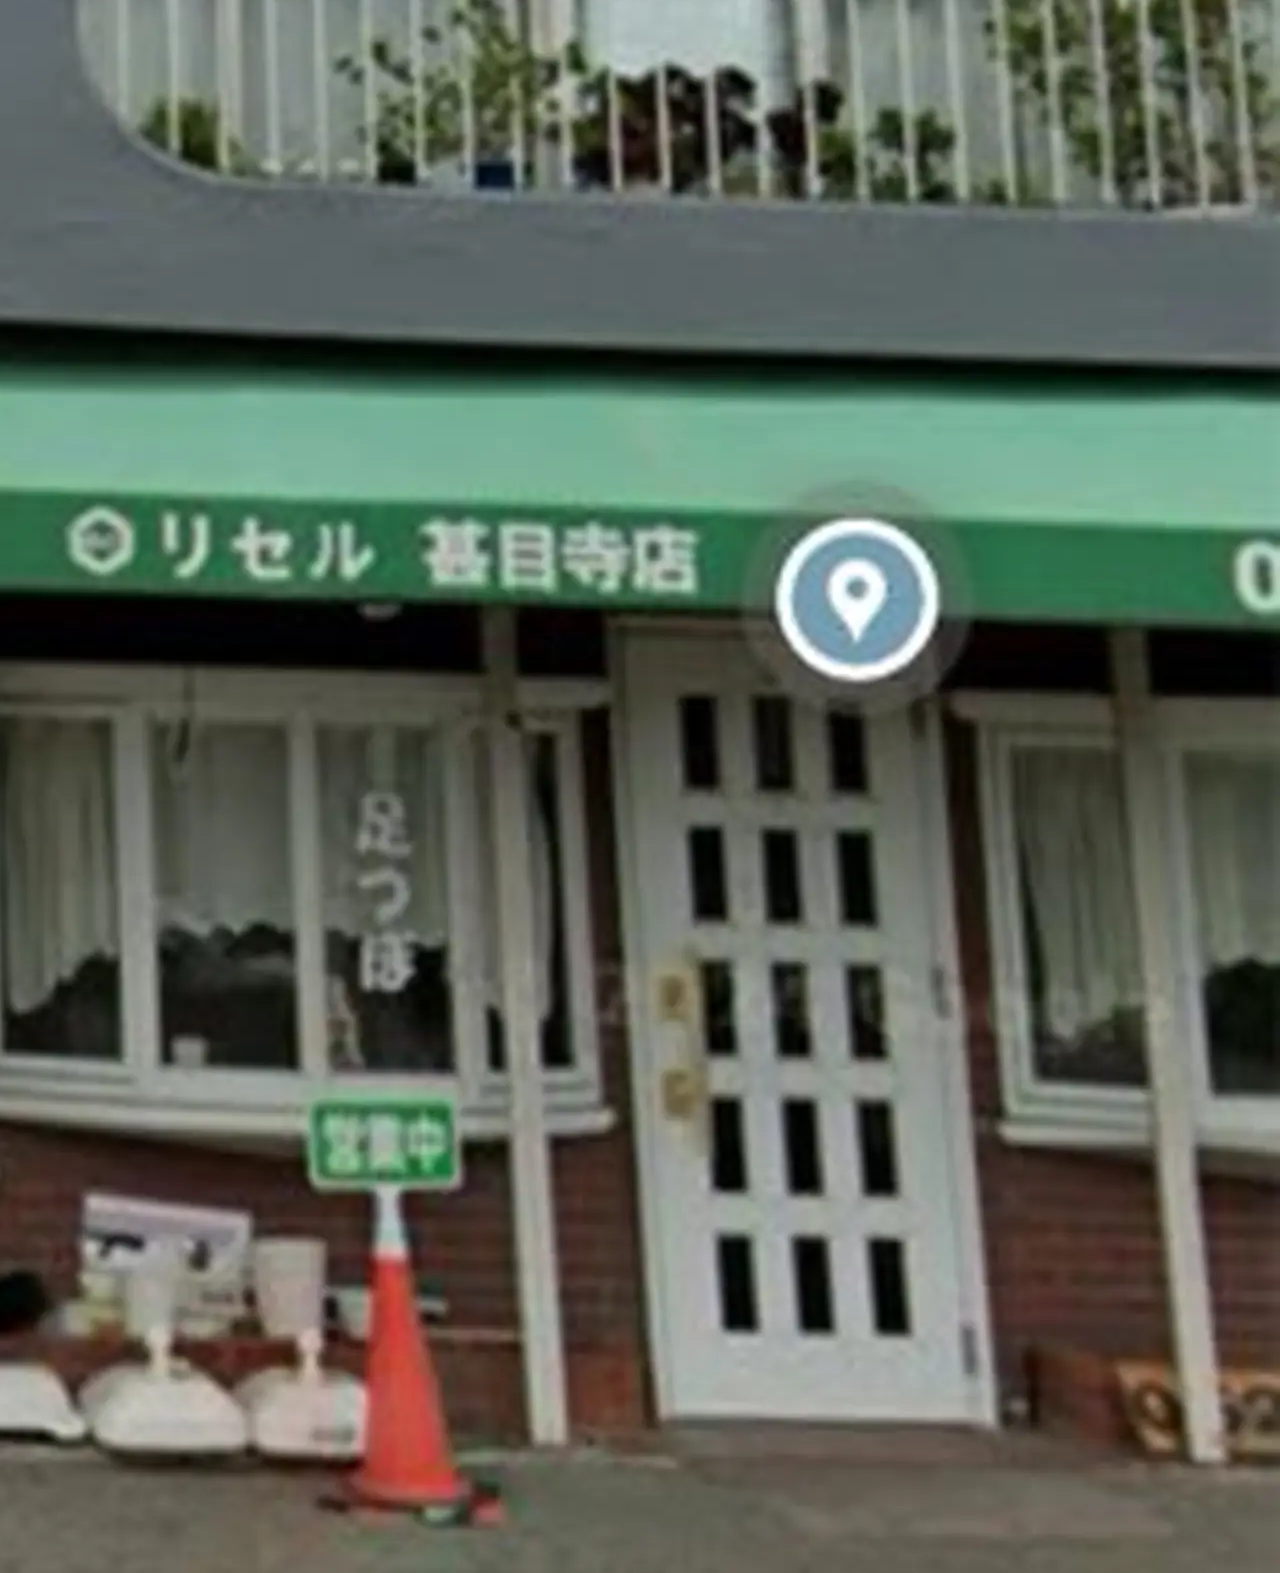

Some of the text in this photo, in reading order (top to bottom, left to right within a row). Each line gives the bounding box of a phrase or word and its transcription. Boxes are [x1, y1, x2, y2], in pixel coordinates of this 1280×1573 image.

[160, 508, 702, 595] リセル 甚目寺店
